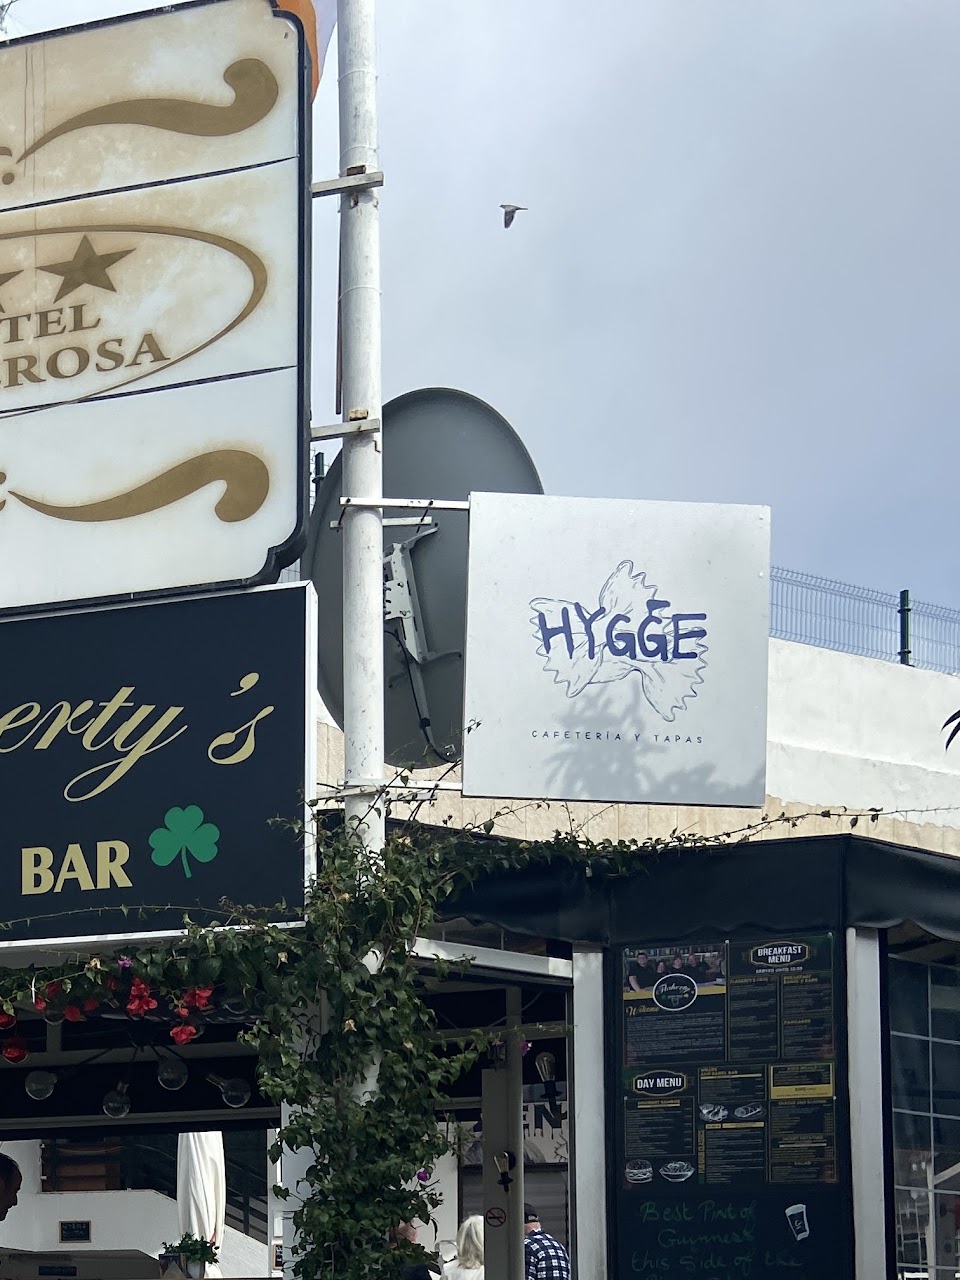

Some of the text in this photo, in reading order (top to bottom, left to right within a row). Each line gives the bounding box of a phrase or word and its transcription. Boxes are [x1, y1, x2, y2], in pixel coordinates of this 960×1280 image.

[537, 599, 708, 661] HYGGE
[531, 728, 703, 744] CAFETERÍA Y TAPAS
[20, 838, 133, 895] BAR
[757, 945, 803, 957] BREAKFAST
[767, 955, 791, 964] MENU
[636, 1077, 682, 1089] DAY MENU
[639, 1200, 694, 1223] Best
